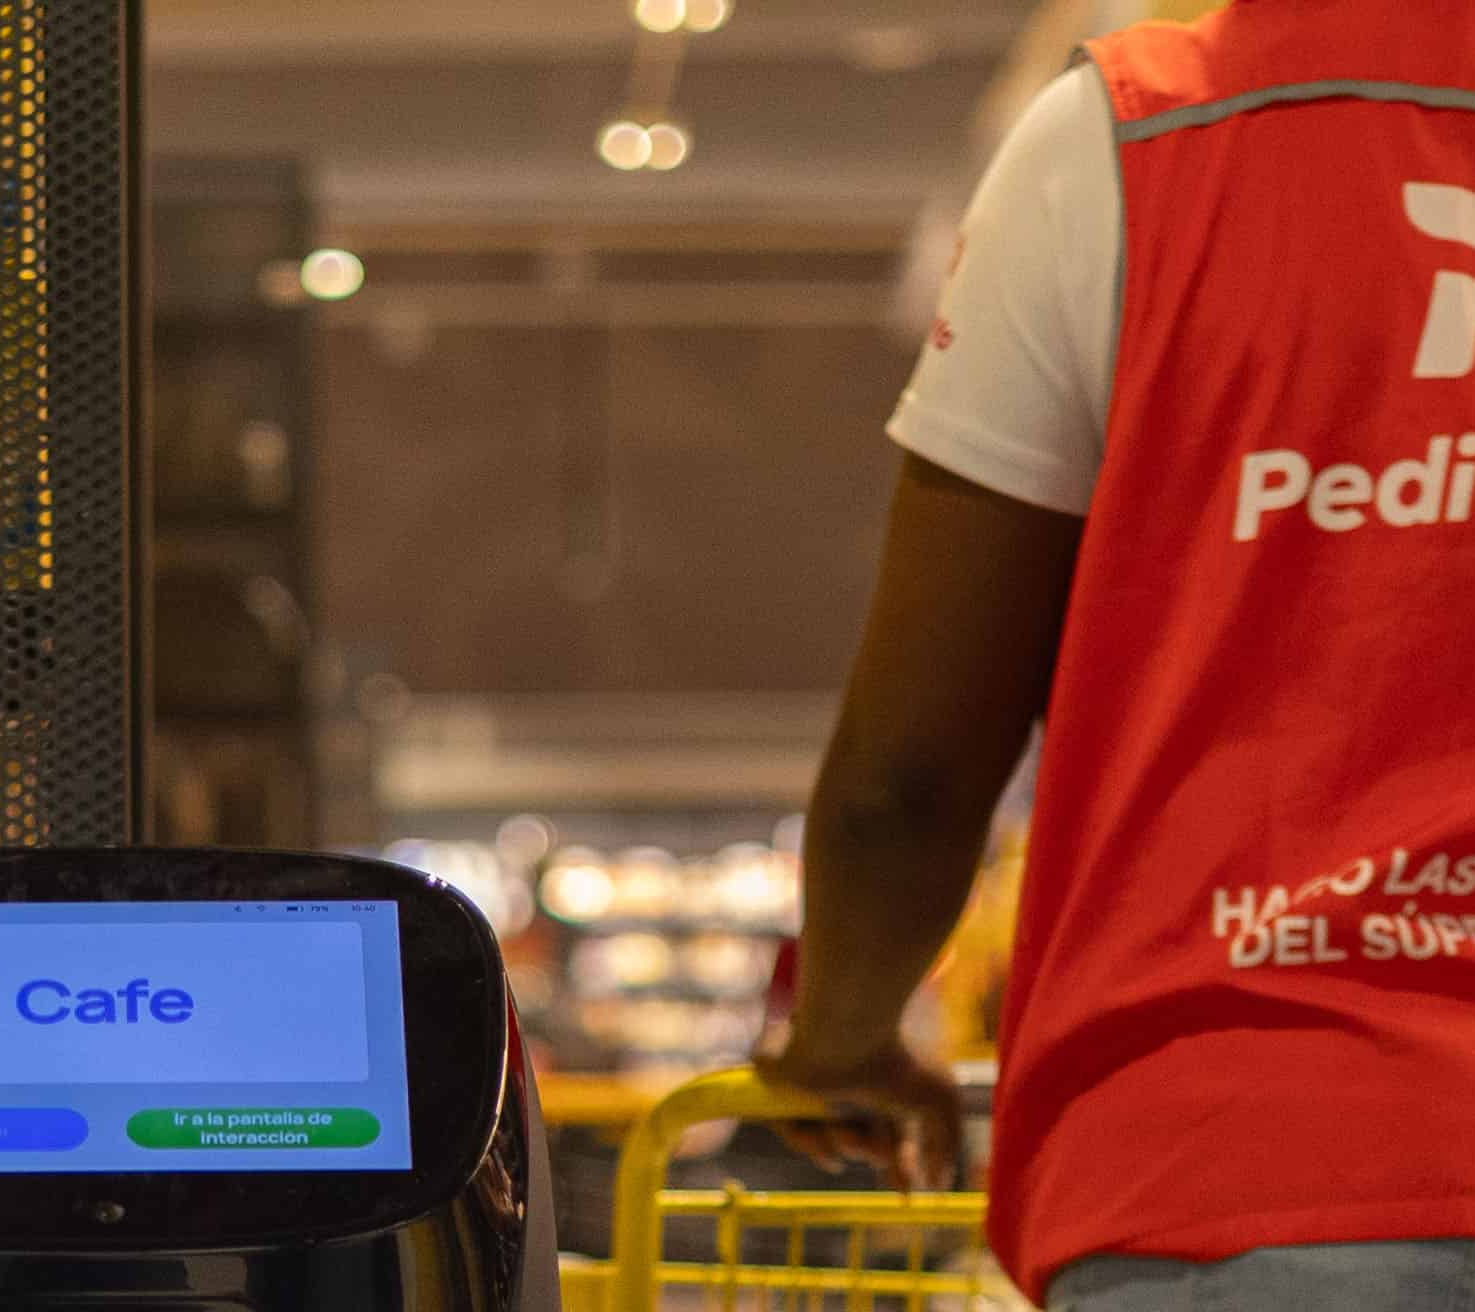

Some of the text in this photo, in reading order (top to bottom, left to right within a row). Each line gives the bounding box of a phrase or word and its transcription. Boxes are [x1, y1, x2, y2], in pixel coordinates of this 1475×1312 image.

[1229, 914, 1349, 969] DEL
[15, 977, 195, 1025] Cafe
[192, 1114, 204, 1126] a
[207, 1111, 224, 1126] la
[227, 1111, 305, 1129] pantalla
[307, 1111, 333, 1126] de
